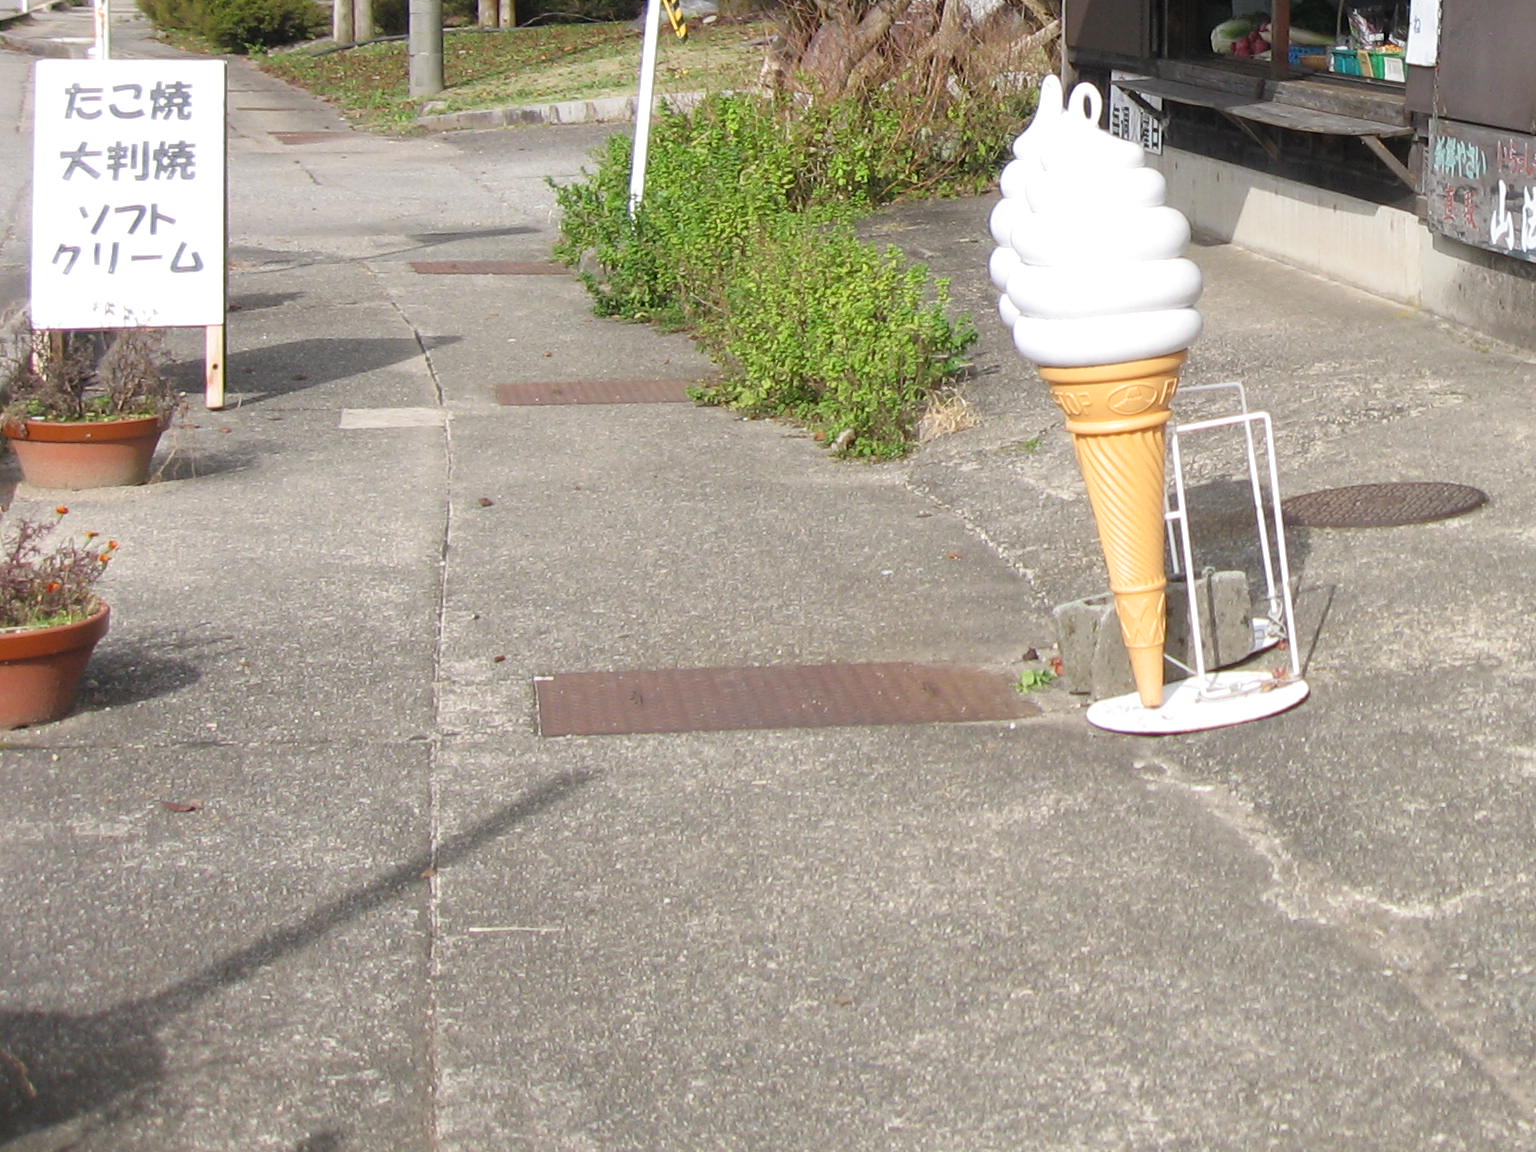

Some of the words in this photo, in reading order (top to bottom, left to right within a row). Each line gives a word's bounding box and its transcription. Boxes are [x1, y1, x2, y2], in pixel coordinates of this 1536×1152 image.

[64, 81, 193, 121] たこ焼
[60, 140, 197, 181] 大判焼
[79, 203, 177, 235] ソフト
[51, 241, 204, 275] クリーム
